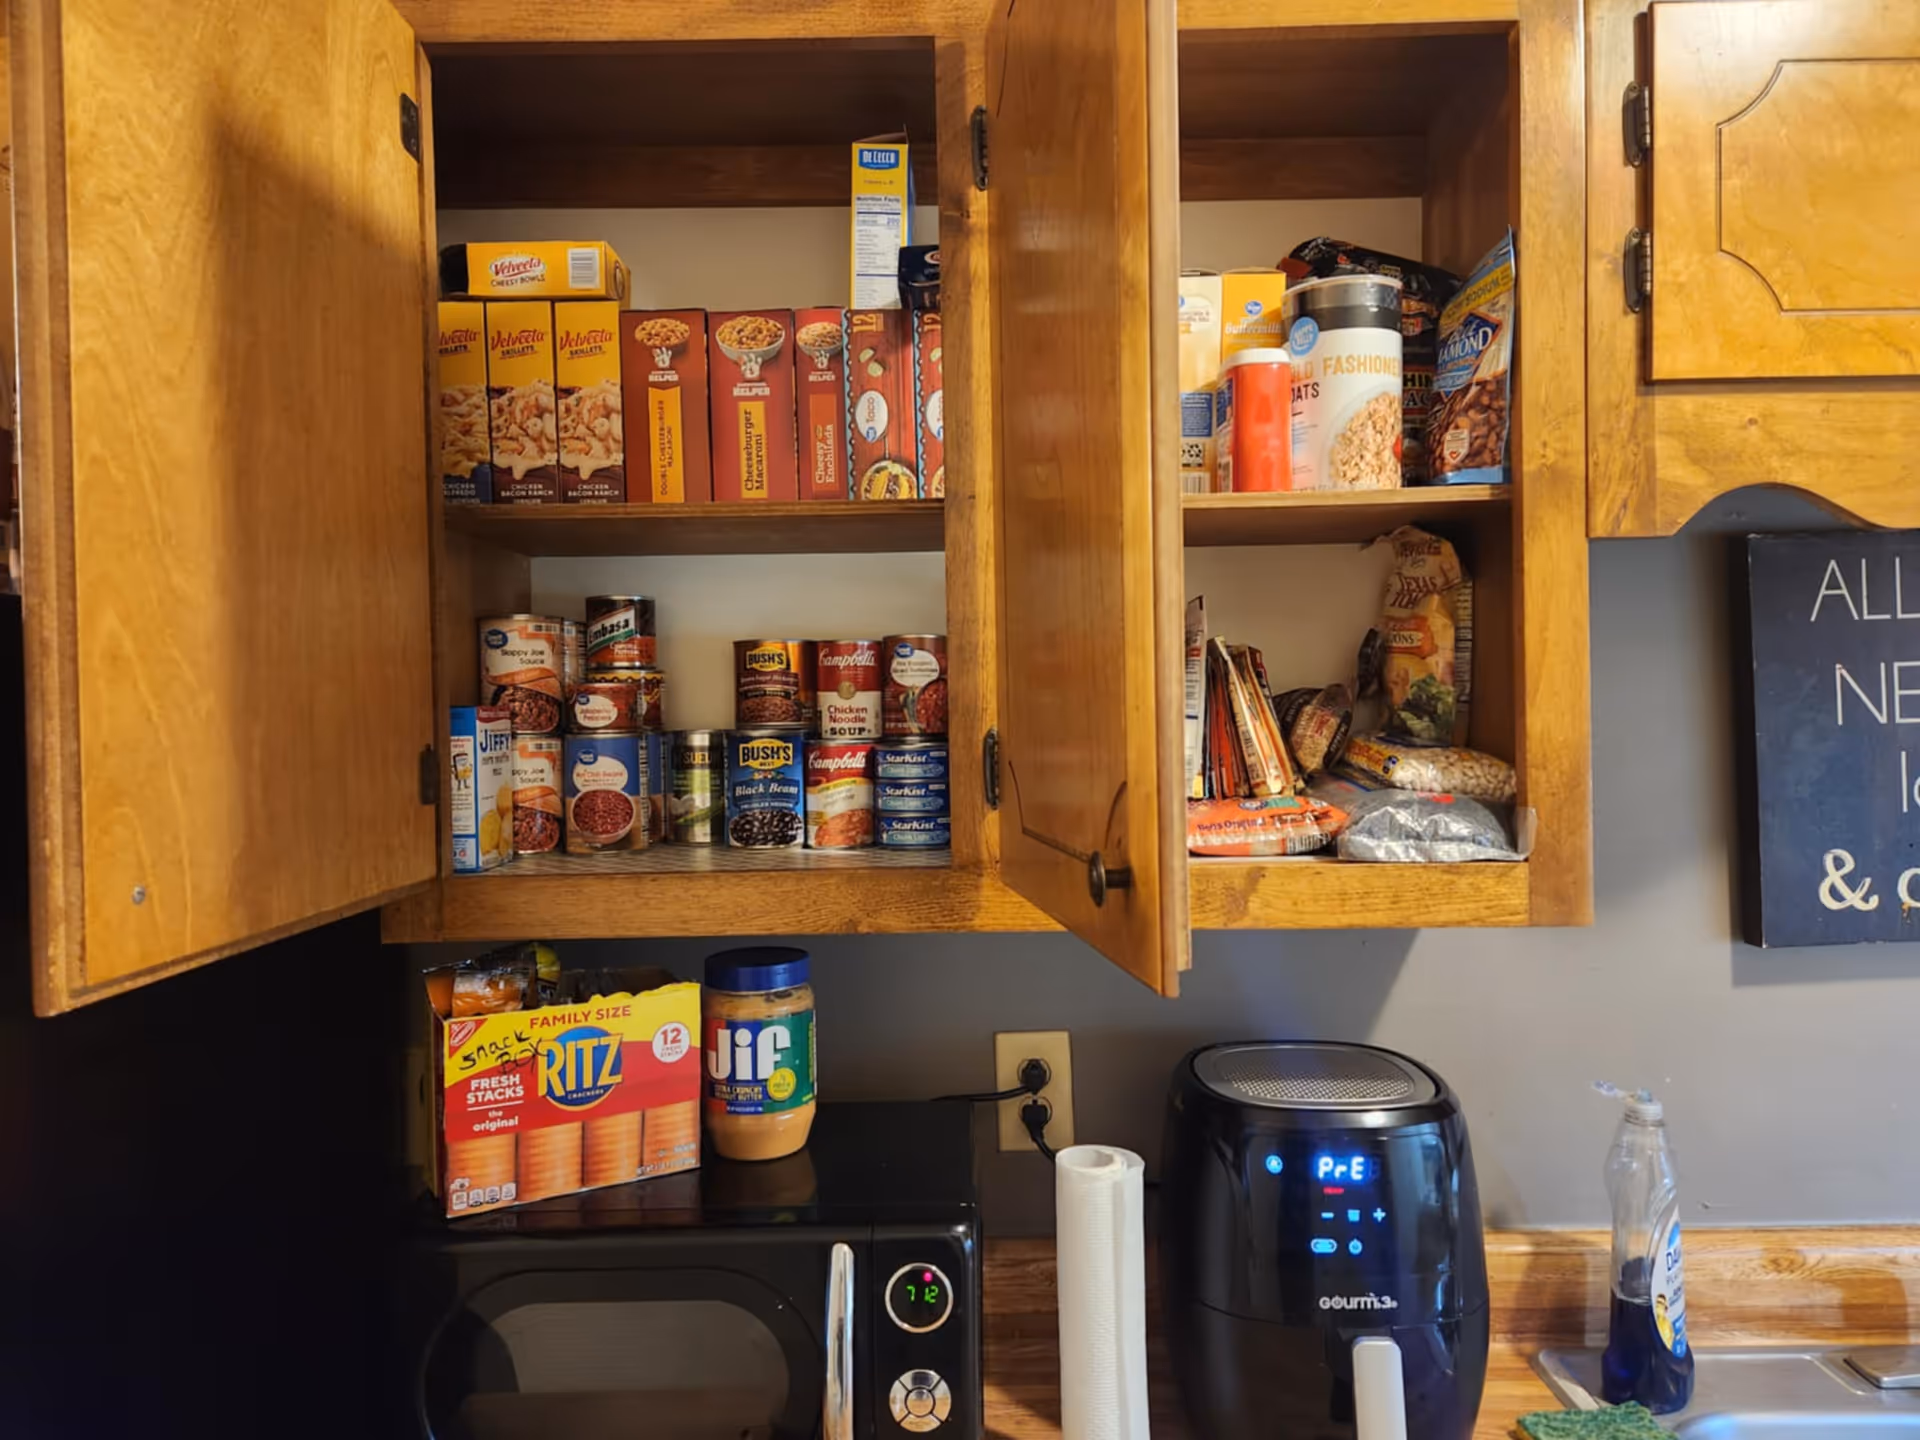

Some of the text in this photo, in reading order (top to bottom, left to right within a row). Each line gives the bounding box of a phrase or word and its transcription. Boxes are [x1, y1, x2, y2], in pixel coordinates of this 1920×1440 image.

[491, 257, 542, 278] Velveeta
[491, 274, 546, 288] CHEESY BOWLS
[440, 328, 480, 346] lveeta
[490, 328, 546, 351] Velveeta
[559, 328, 615, 351] Velveeta
[743, 409, 755, 492] Cheeseburger
[824, 423, 835, 484] Enchilada
[755, 433, 766, 491] Macaroni
[815, 441, 825, 484] Cheesy
[1810, 557, 1920, 623] ALL
[519, 657, 545, 665] Sauce
[828, 704, 868, 715] Chicken
[829, 714, 867, 724] Noodle
[829, 726, 867, 735] SOUP
[480, 729, 511, 753] JIFFY
[742, 745, 791, 763] BUSH'S
[808, 751, 867, 773] Campbell's
[885, 752, 928, 764] StarKist
[519, 775, 545, 783] Sauce
[735, 783, 765, 797] Black
[884, 785, 926, 796] StarKist
[891, 819, 936, 831] StarKist
[530, 1005, 632, 1029] FAMILY SIZE
[660, 1028, 682, 1045] 12
[708, 1025, 791, 1081] Jif
[537, 1033, 624, 1098] RITZ
[470, 1073, 521, 1091] FRESH
[466, 1086, 524, 1104] STACKS
[488, 1109, 503, 1117] the
[472, 1116, 519, 1132] original
